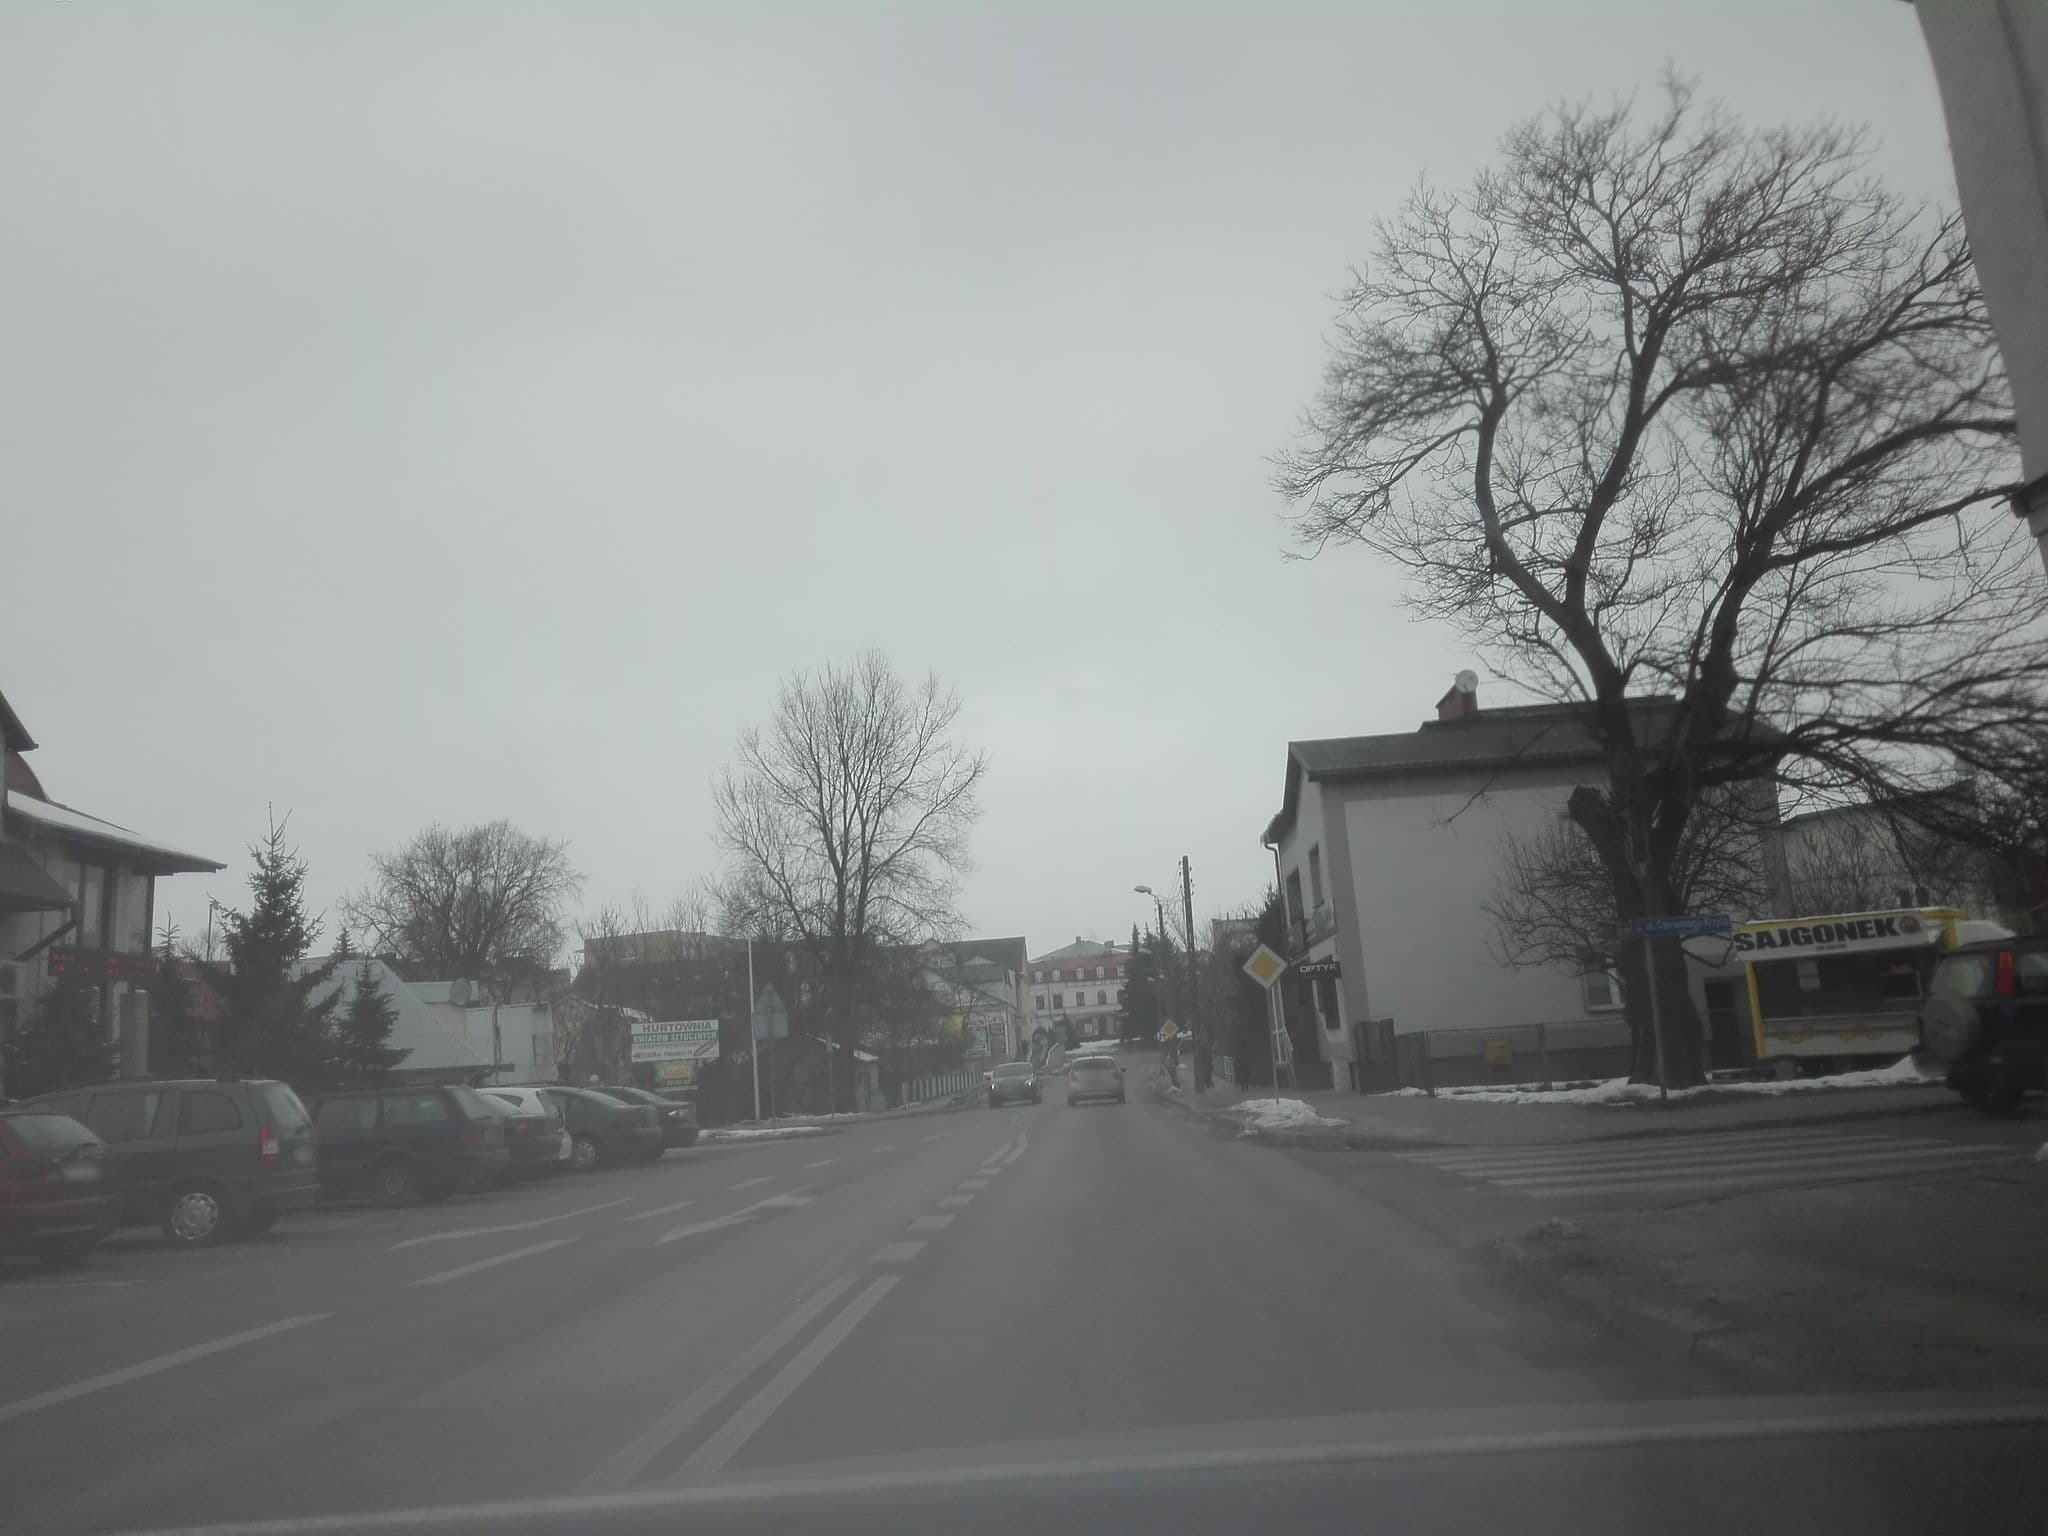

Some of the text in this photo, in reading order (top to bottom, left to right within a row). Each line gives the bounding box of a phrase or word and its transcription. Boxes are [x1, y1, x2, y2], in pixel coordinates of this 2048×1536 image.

[1733, 917, 1898, 951] SAJGONEK
[1300, 963, 1336, 973] OPTYK
[642, 1022, 712, 1033] HURTOWNIA
